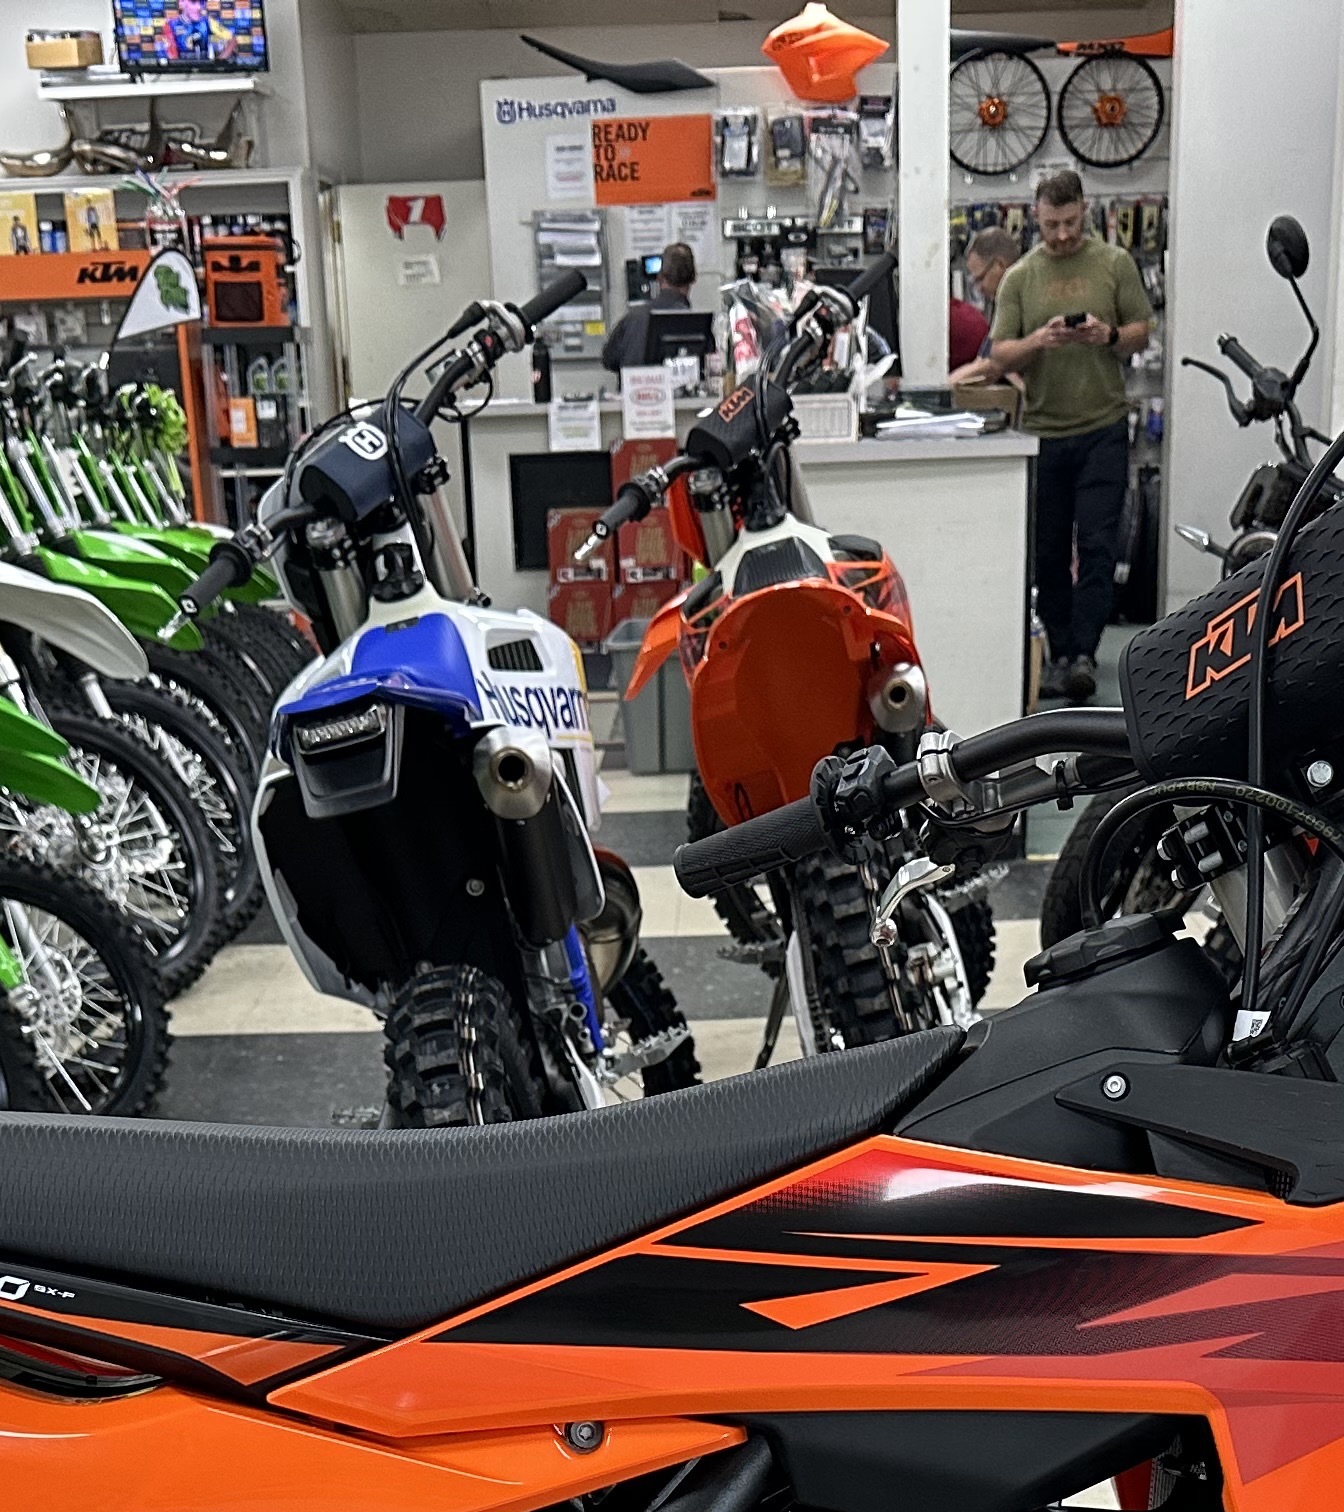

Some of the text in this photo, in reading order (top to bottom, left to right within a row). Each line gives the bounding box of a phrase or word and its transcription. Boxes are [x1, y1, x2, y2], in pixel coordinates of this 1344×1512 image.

[518, 98, 616, 120] Husqvarna
[592, 122, 650, 143] READY
[594, 144, 616, 163] TO
[594, 162, 640, 182] RACE
[76, 261, 139, 284] KTM
[1184, 571, 1304, 701] KTM
